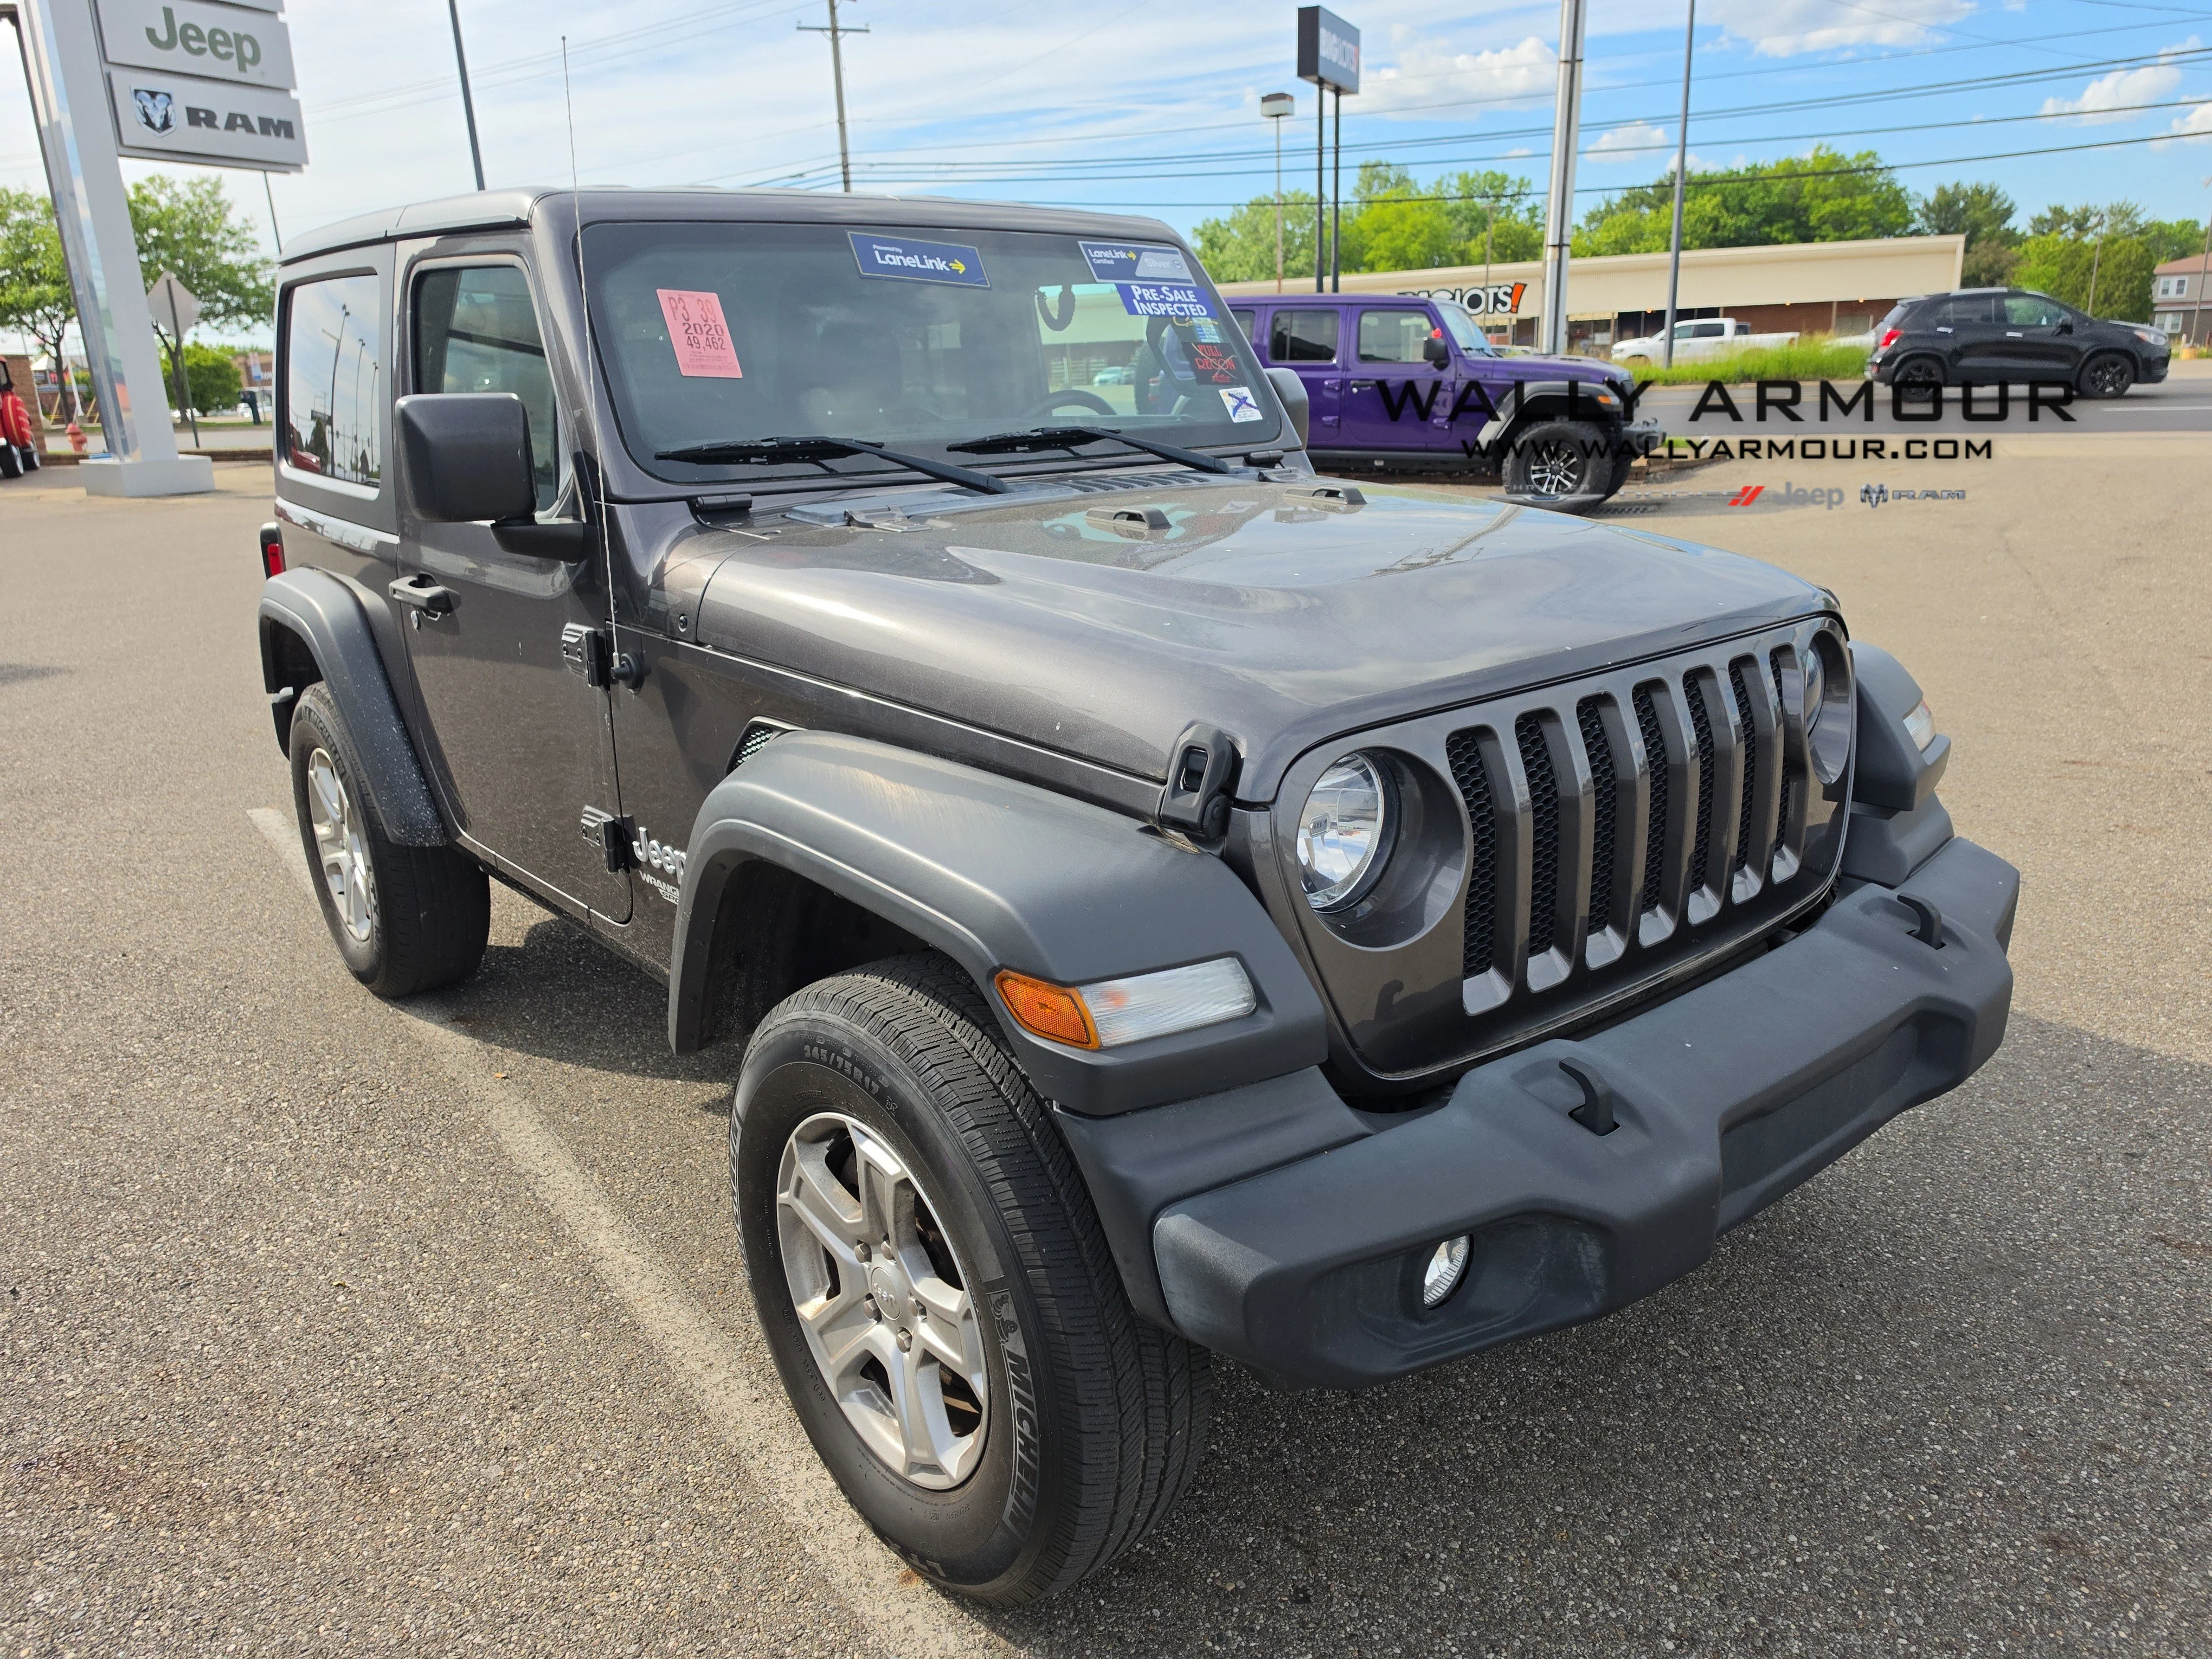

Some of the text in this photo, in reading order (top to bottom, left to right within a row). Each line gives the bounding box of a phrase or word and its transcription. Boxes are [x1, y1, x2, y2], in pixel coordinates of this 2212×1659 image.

[145, 6, 261, 73] Jeep
[185, 106, 296, 140] RAM
[874, 250, 950, 272] LaneLink
[1088, 248, 1129, 260] LaneLink
[1143, 257, 1172, 269] Silver
[1130, 285, 1198, 303] PRE-SALE
[668, 296, 717, 324] P3 39
[1133, 299, 1208, 316] INSPECTED
[682, 322, 725, 337] 2020
[686, 336, 726, 351] 49,462
[1197, 344, 1223, 357] FULL
[1194, 358, 1237, 370] RECON
[632, 826, 686, 886] Jeep
[1006, 1349, 1040, 1539] MICHELIN
